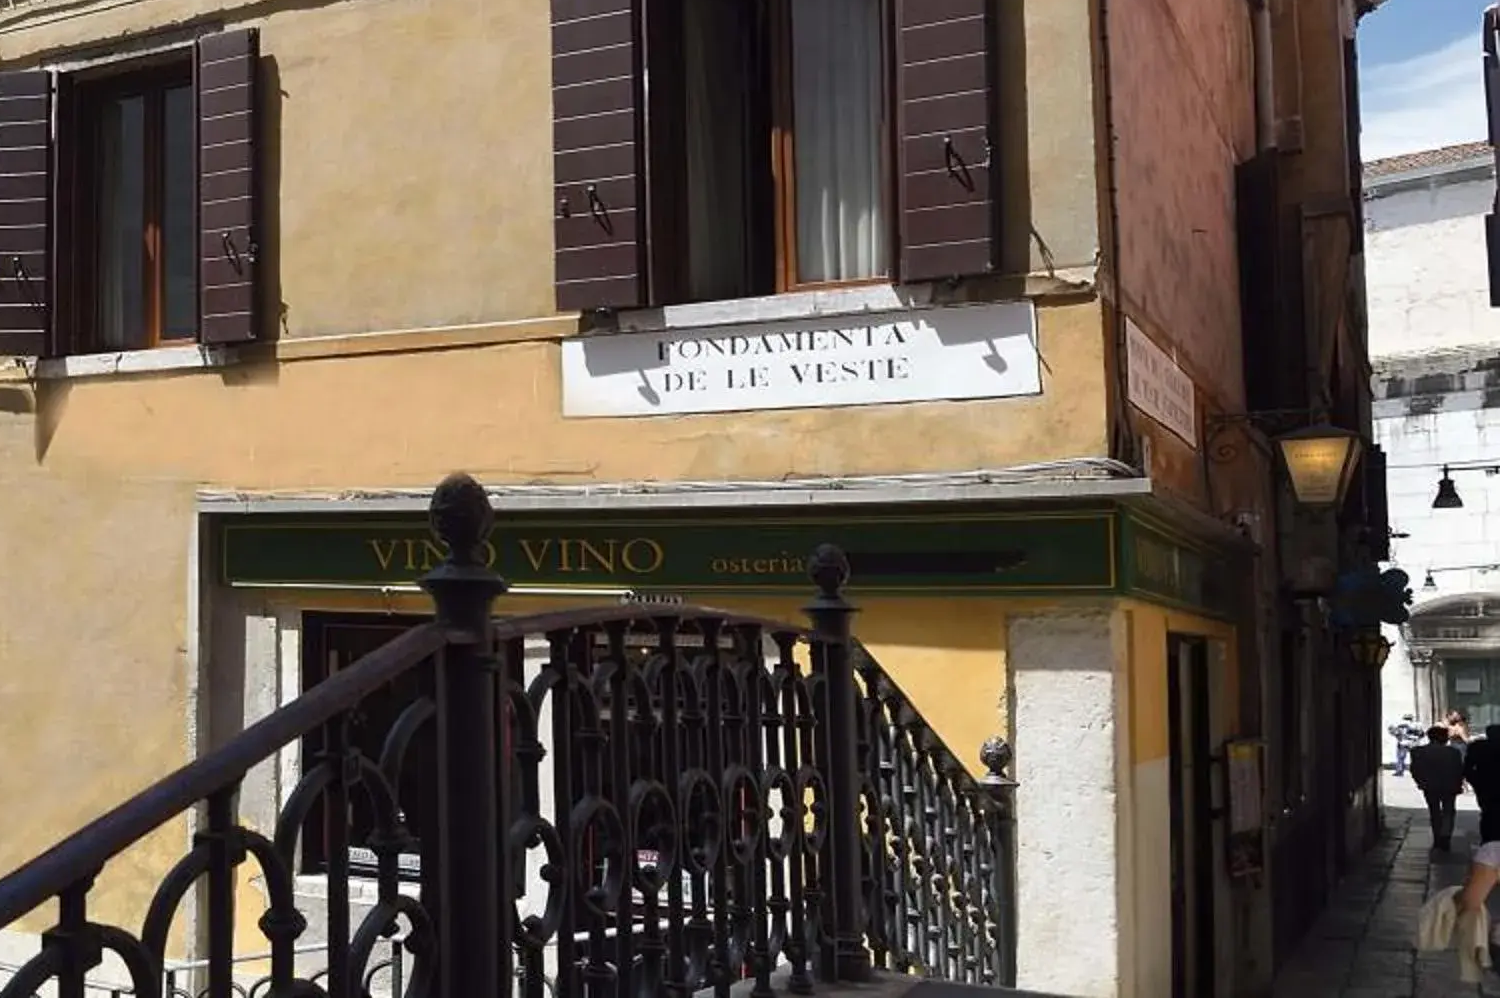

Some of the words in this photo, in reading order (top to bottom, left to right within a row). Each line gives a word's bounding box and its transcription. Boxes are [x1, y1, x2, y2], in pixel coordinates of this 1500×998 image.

[657, 323, 908, 362] FONDAMENTA
[663, 370, 708, 393] DE
[726, 365, 770, 390] LE
[789, 356, 910, 384] VESTE
[518, 537, 664, 573] VINO
[711, 550, 806, 574] osteria
